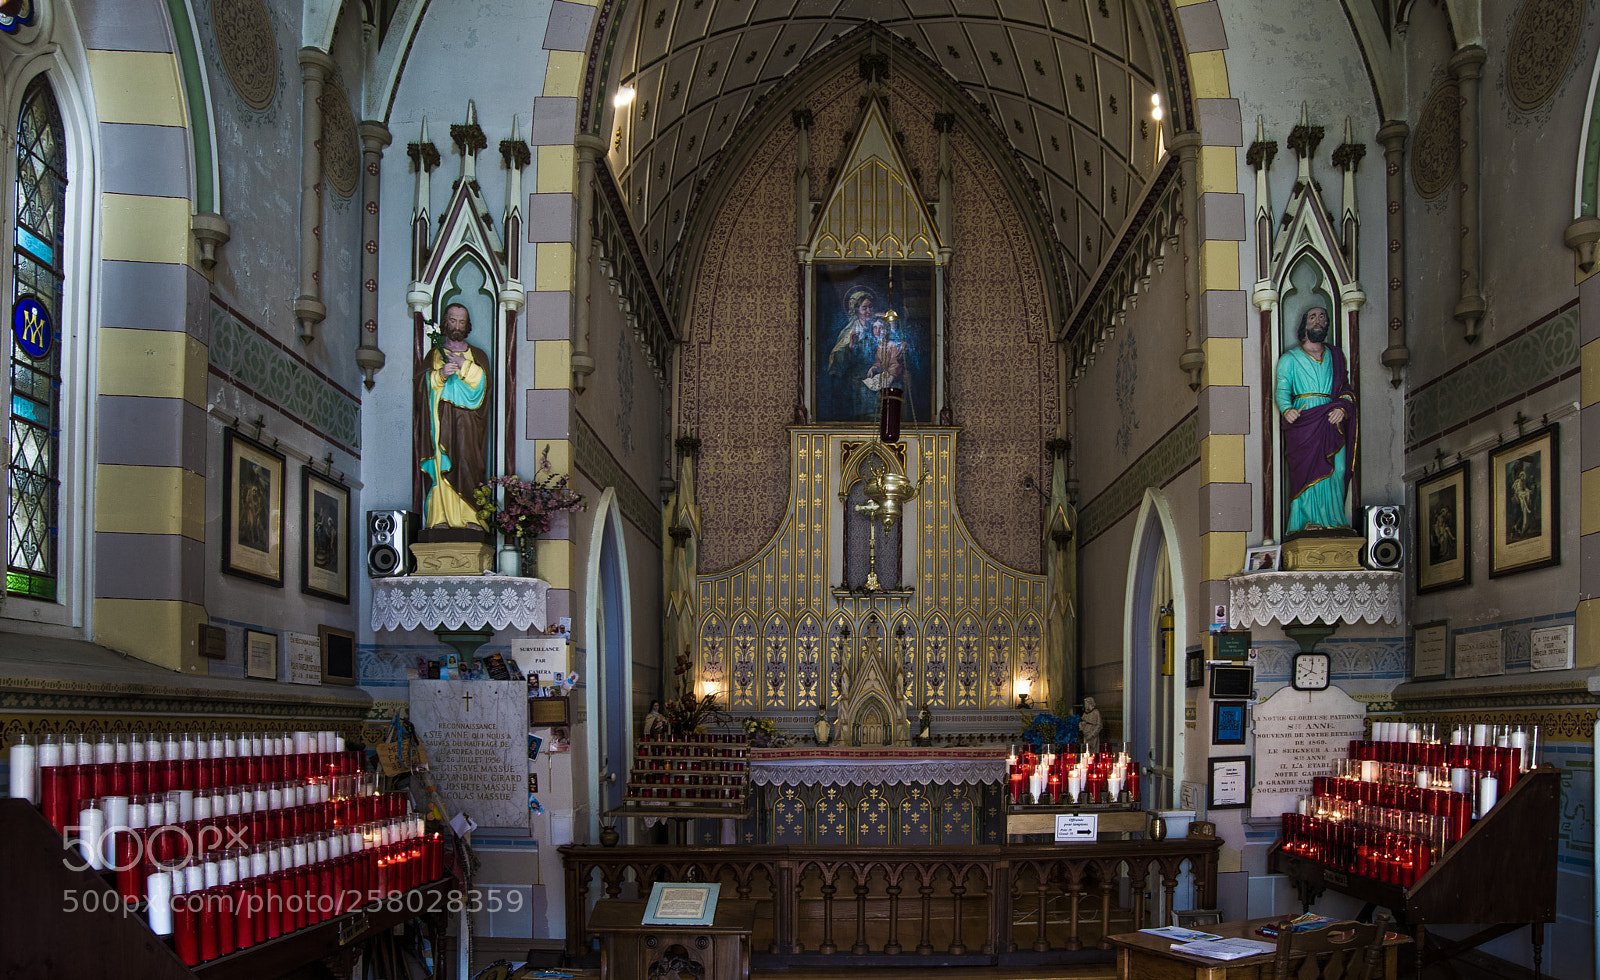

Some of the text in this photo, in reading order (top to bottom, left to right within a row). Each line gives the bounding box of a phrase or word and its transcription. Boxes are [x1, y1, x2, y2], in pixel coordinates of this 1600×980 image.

[445, 731, 467, 739] ANNE
[441, 764, 477, 772] GUSTAVE
[480, 765, 515, 773] MASSUE
[430, 774, 488, 782] ALEXANDRINE
[490, 774, 522, 782] GIRARD
[482, 783, 517, 792] MASSUE
